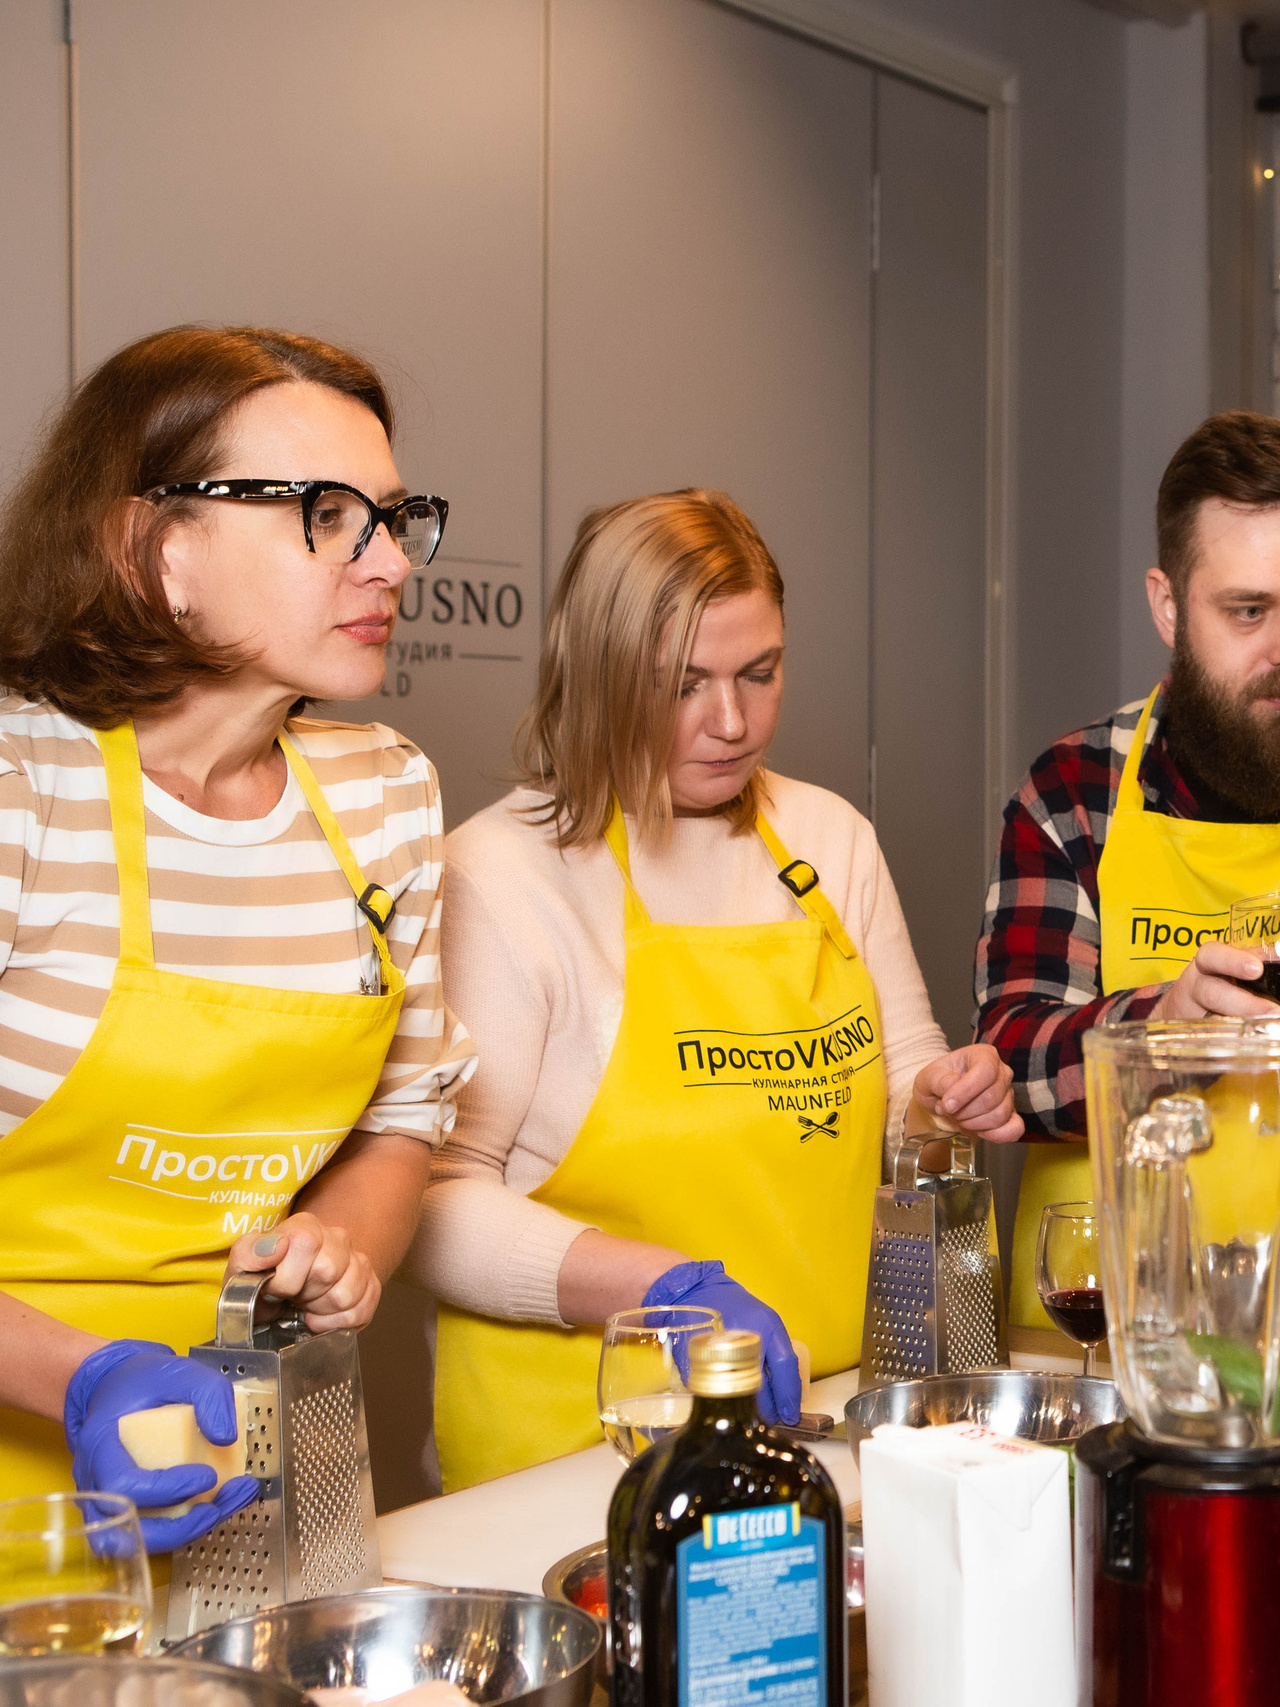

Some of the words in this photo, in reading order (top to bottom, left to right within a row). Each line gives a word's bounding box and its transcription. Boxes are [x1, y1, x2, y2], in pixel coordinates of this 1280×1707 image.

[399, 576, 522, 628] USNO
[677, 1015, 875, 1077] ПростоVKUSNO
[752, 1075, 828, 1090] КУЛИНАРНАЯ
[767, 1086, 852, 1112] MAUNFELD
[116, 1134, 342, 1183] ПростоVK
[208, 1190, 295, 1208] КУЛИНАРН
